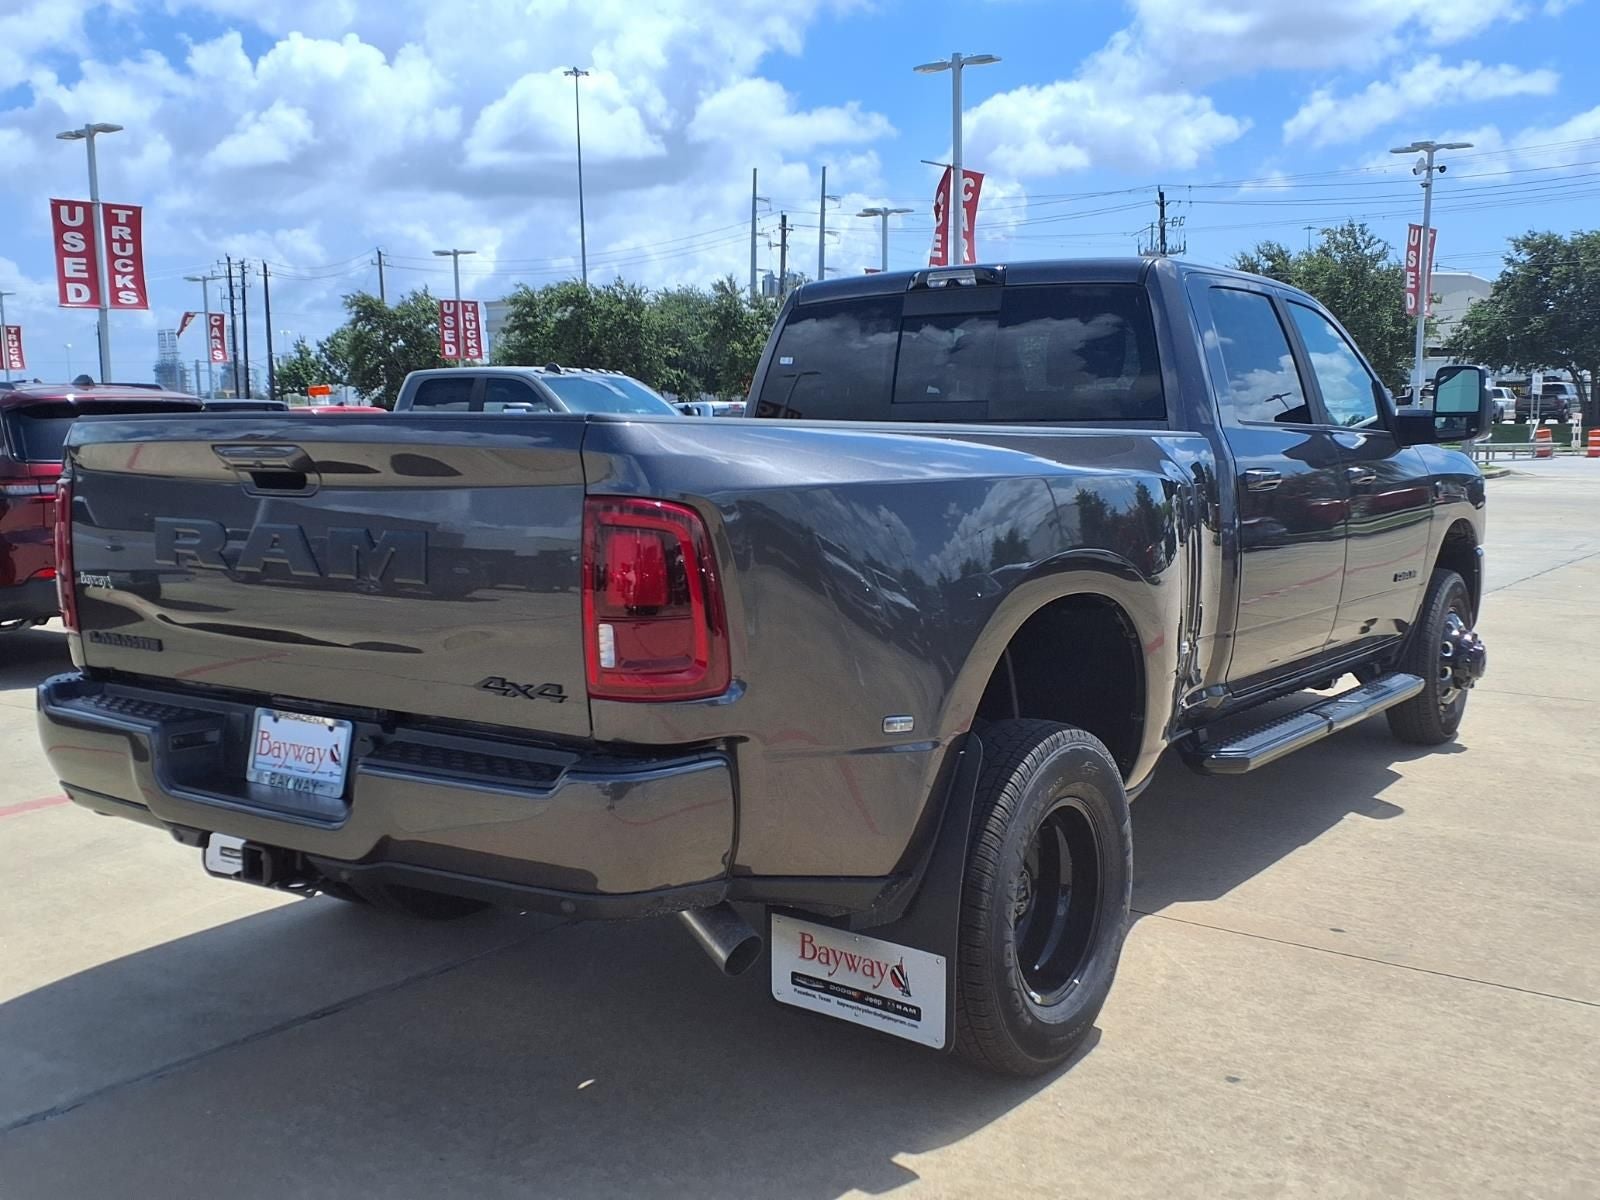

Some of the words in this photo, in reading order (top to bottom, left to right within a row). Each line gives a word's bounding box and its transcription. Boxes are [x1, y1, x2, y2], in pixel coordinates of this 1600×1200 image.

[60, 205, 91, 304] USED
[111, 209, 139, 305] TRUCKS
[1406, 228, 1419, 310] USED
[210, 315, 224, 360] CARS
[443, 302, 457, 356] USED
[464, 303, 479, 356] TRUCKS
[154, 517, 429, 585] RAM
[256, 730, 328, 775] Bayway
[798, 931, 890, 989] Bayway
[865, 995, 882, 1006] Jeep
[896, 1003, 917, 1015] RAM
